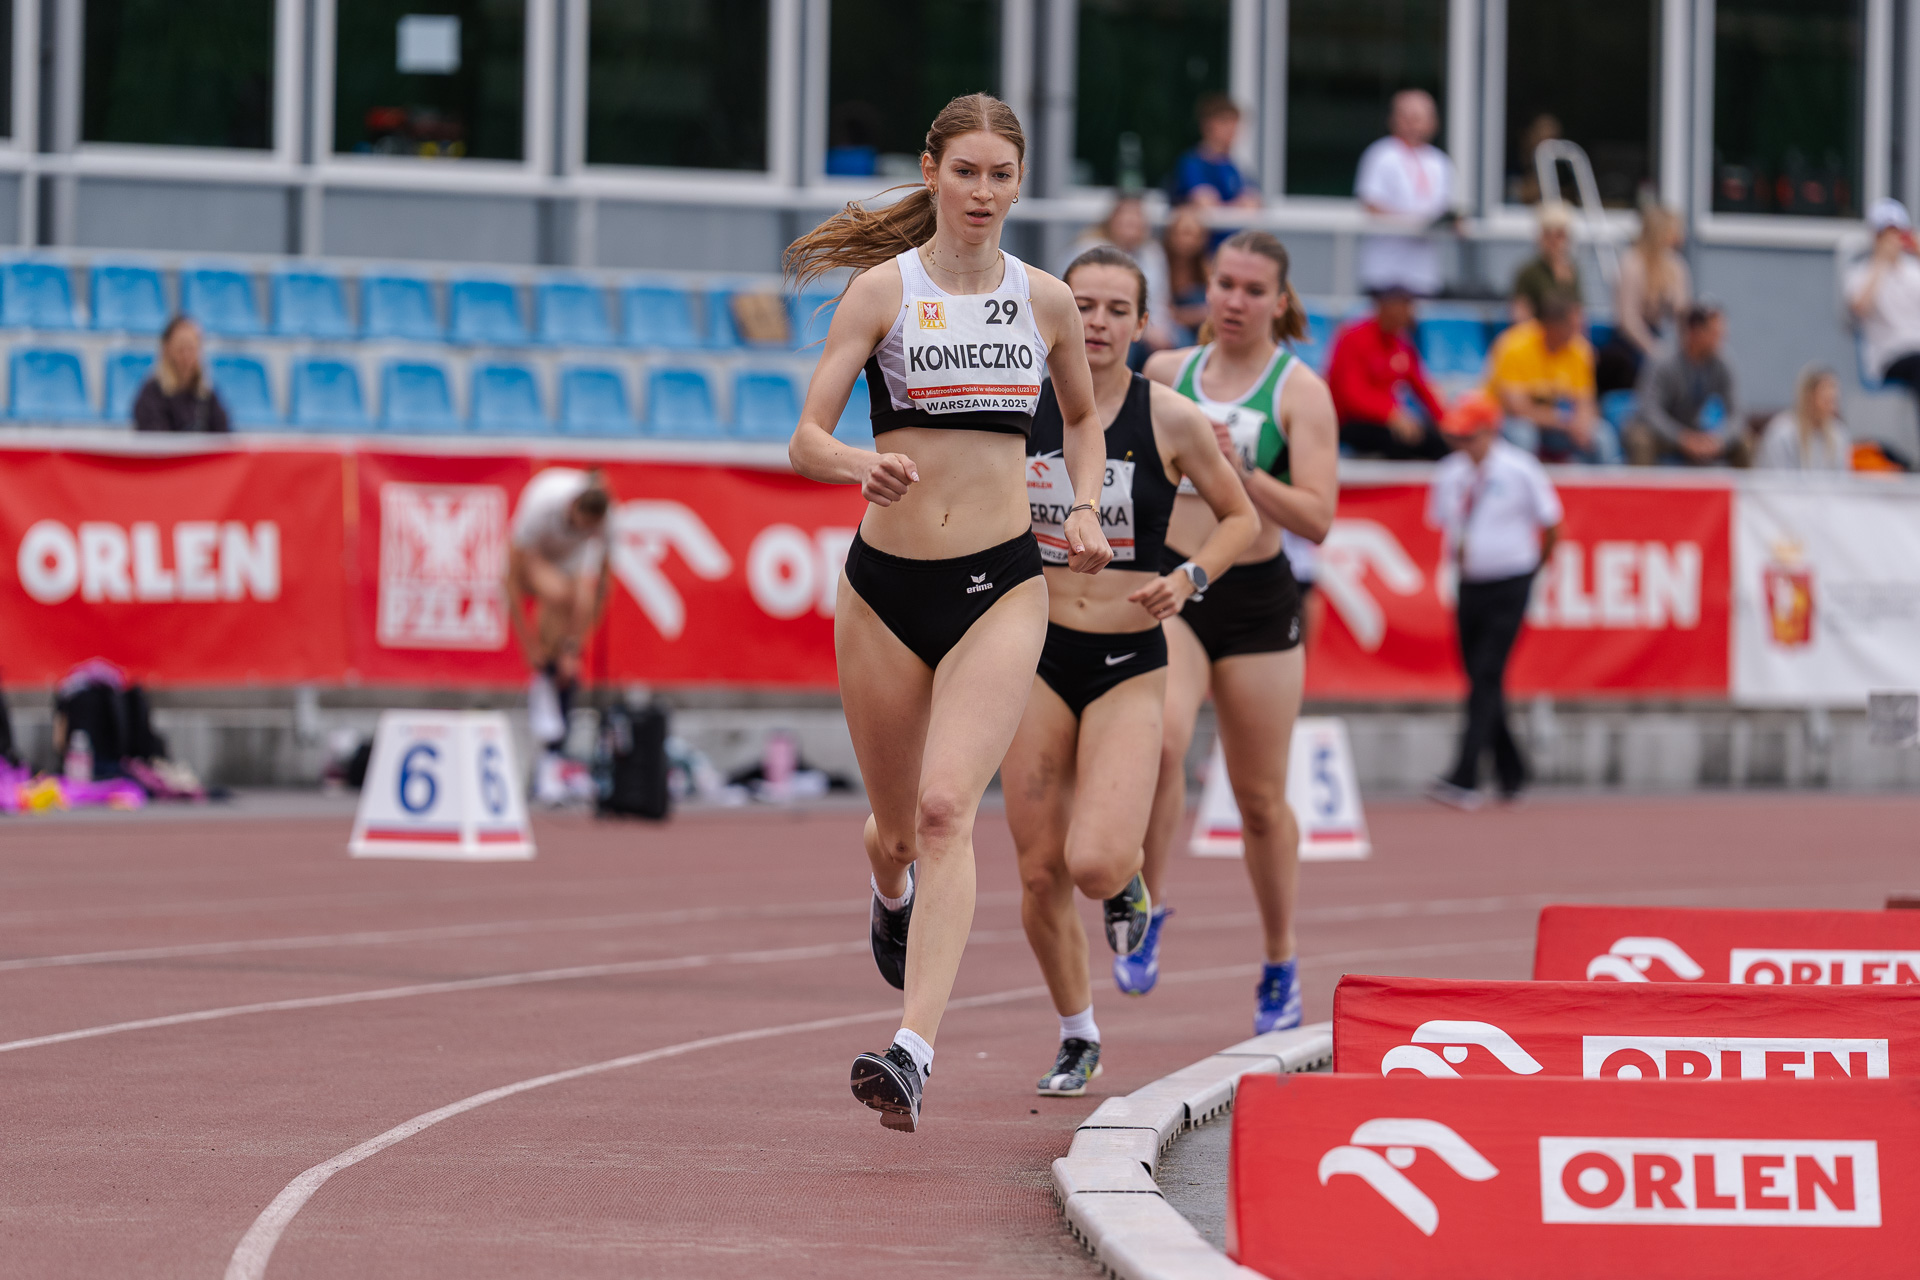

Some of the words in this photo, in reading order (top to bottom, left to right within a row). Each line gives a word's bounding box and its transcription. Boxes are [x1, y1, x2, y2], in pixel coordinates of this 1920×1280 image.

[921, 319, 945, 328] PZLA
[984, 299, 1018, 325] 29
[909, 343, 1033, 372] KONIECZKO
[926, 399, 1000, 411] WARSZAWA
[1001, 399, 1028, 408] 2025
[17, 519, 281, 604] ORLEN
[966, 583, 993, 594] erima
[397, 743, 440, 817] 6
[478, 744, 509, 817] 6
[1311, 749, 1343, 819] 5
[1561, 1151, 1854, 1211] ORLEN
